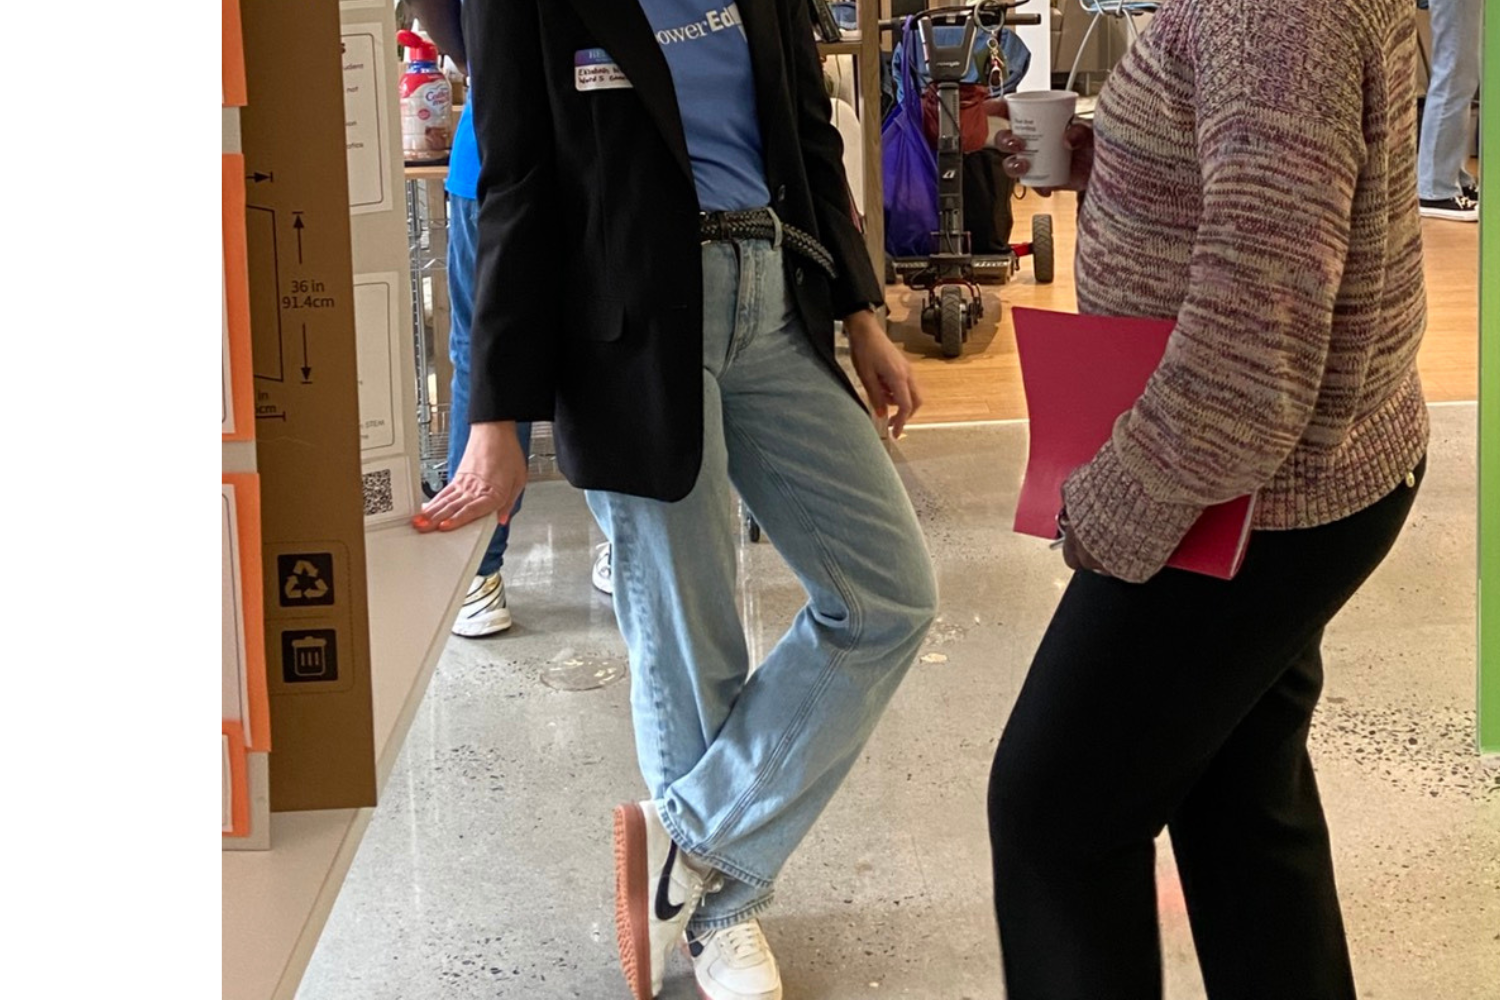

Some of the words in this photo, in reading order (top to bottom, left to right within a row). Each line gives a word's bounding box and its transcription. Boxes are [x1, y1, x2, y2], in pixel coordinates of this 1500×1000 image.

[656, 8, 735, 45] owerEd
[291, 280, 308, 293] 36
[311, 279, 325, 293] in
[282, 296, 335, 309] 91.4cm
